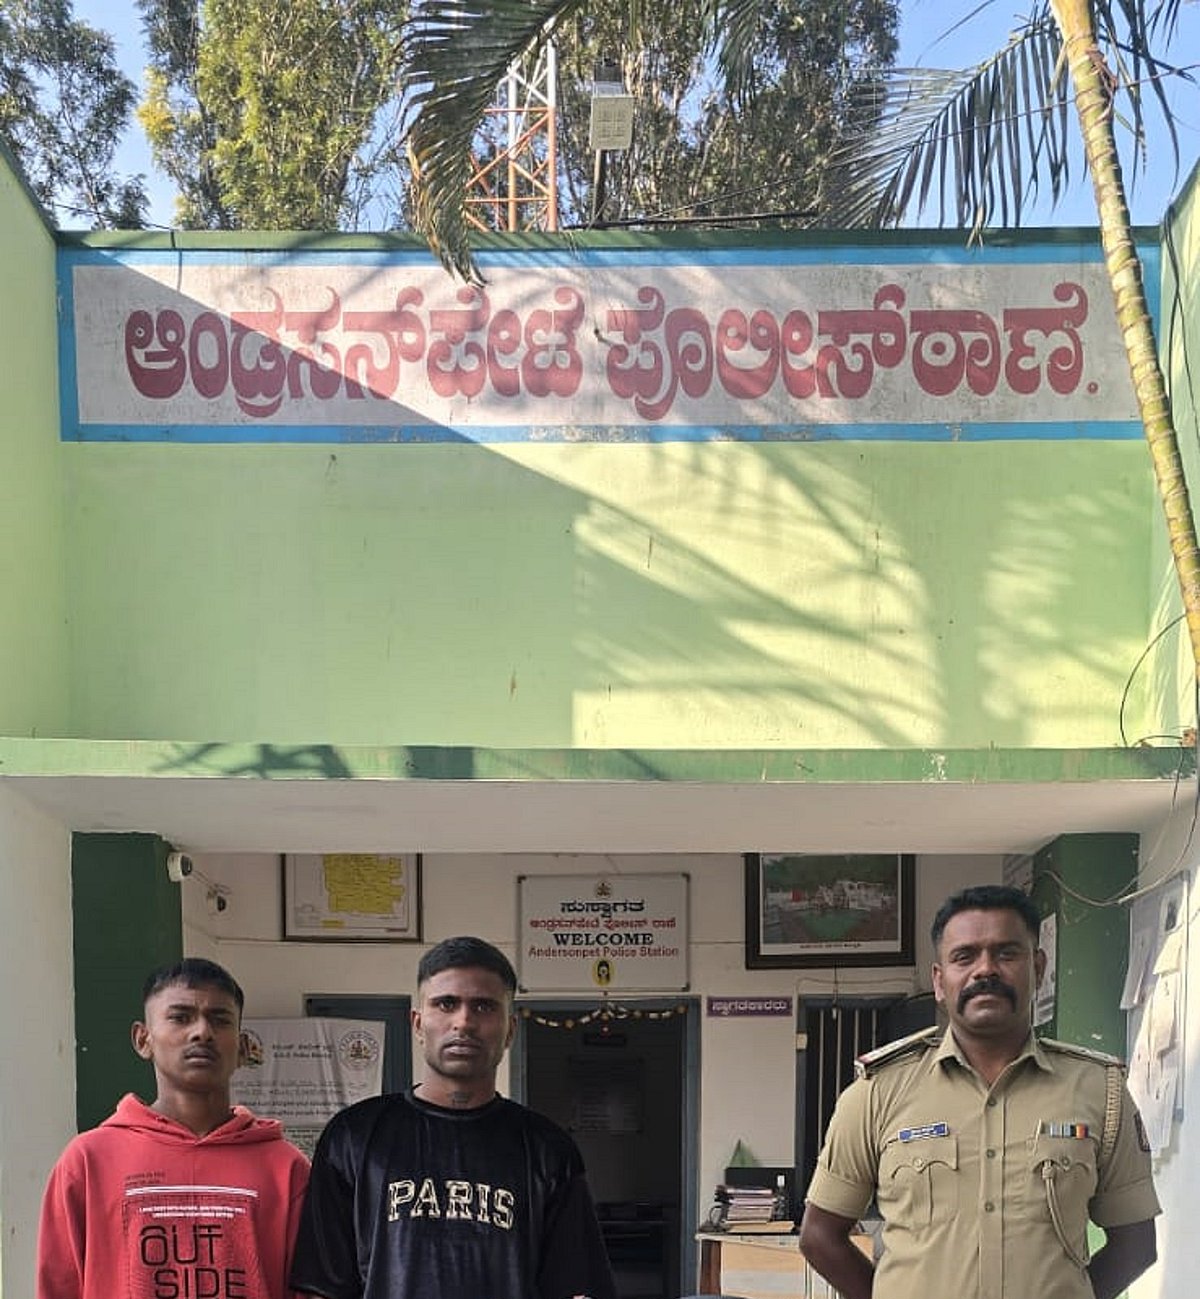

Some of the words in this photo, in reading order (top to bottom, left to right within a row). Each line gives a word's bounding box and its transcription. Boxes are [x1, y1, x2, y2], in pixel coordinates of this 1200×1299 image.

[561, 899, 645, 918] ಸುಸ್ವಾಗತ
[553, 933, 653, 946] WELCOME
[528, 947, 600, 959] Andersonpet
[603, 947, 636, 957] Police
[639, 946, 679, 957] Station
[388, 1178, 515, 1230] PARIS
[140, 1224, 223, 1266] OUT
